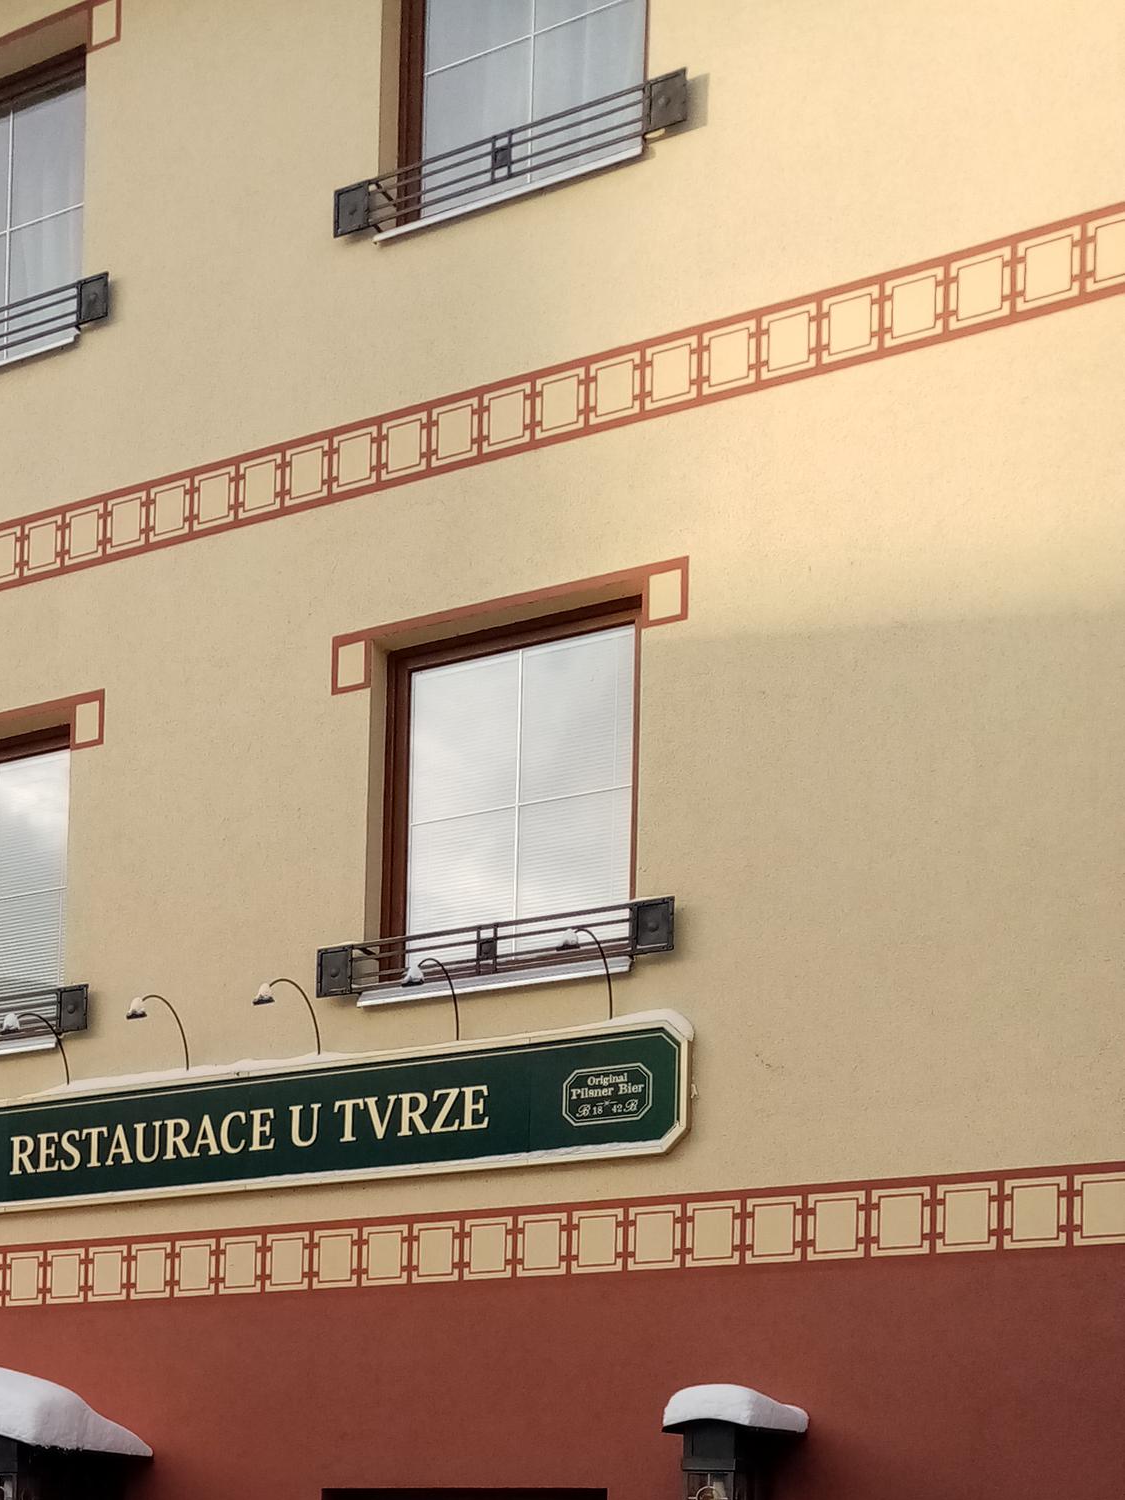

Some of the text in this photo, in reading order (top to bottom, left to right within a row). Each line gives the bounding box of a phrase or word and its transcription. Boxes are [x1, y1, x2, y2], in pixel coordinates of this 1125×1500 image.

[587, 1072, 628, 1087] Original
[570, 1083, 645, 1100] Pilsner Bier
[9, 1084, 490, 1176] RESTAURACE U TVRZE
